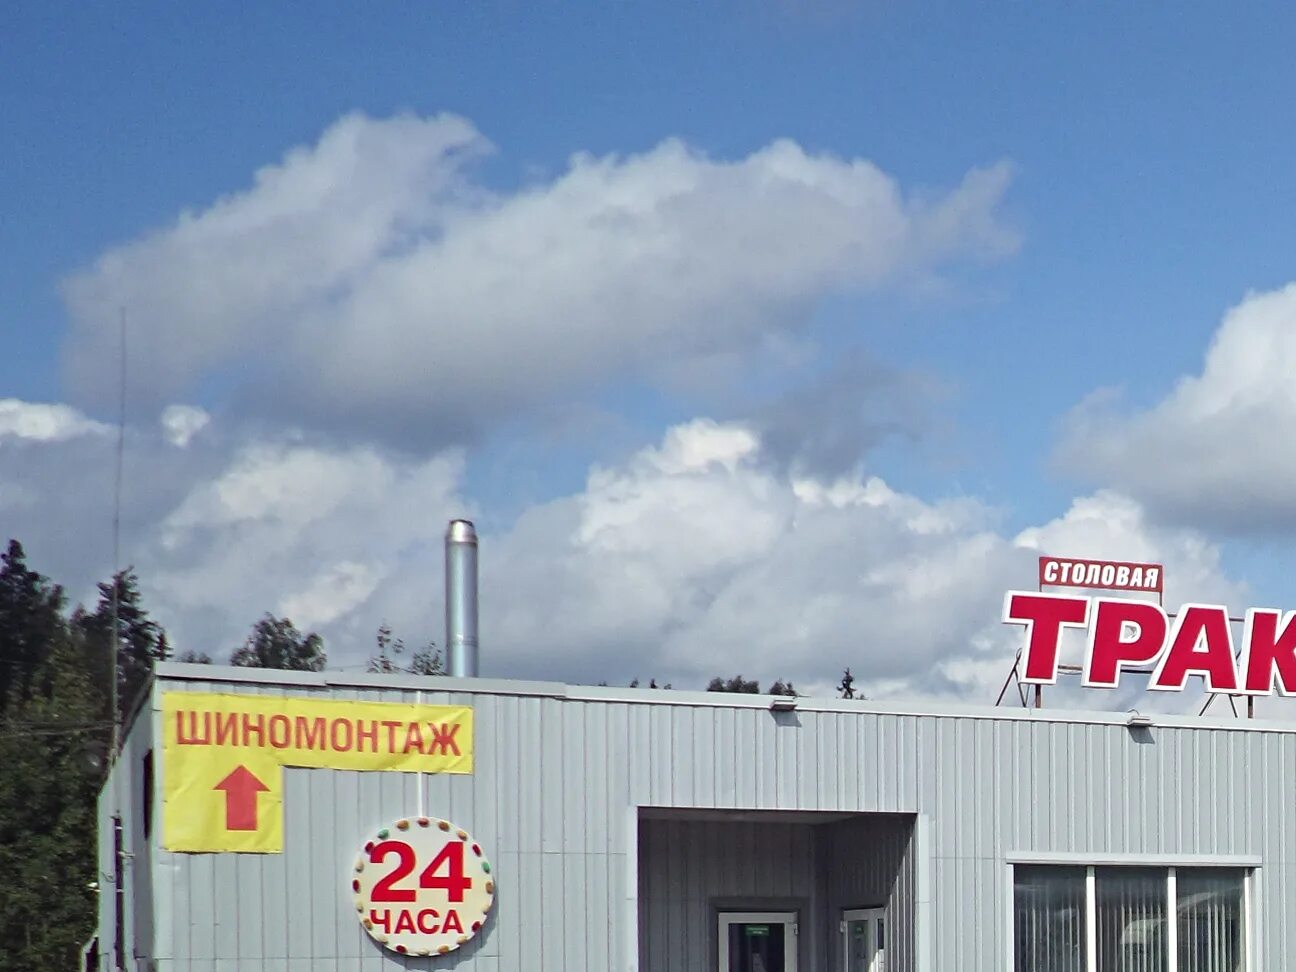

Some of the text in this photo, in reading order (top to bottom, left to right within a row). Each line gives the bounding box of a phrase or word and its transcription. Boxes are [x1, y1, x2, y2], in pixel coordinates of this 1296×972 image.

[1044, 561, 1159, 588] СТОЛОВАЯ
[176, 711, 461, 757] ШИНОМОНТАЖ
[369, 840, 472, 903] 24
[369, 909, 465, 935] ЧАСА
